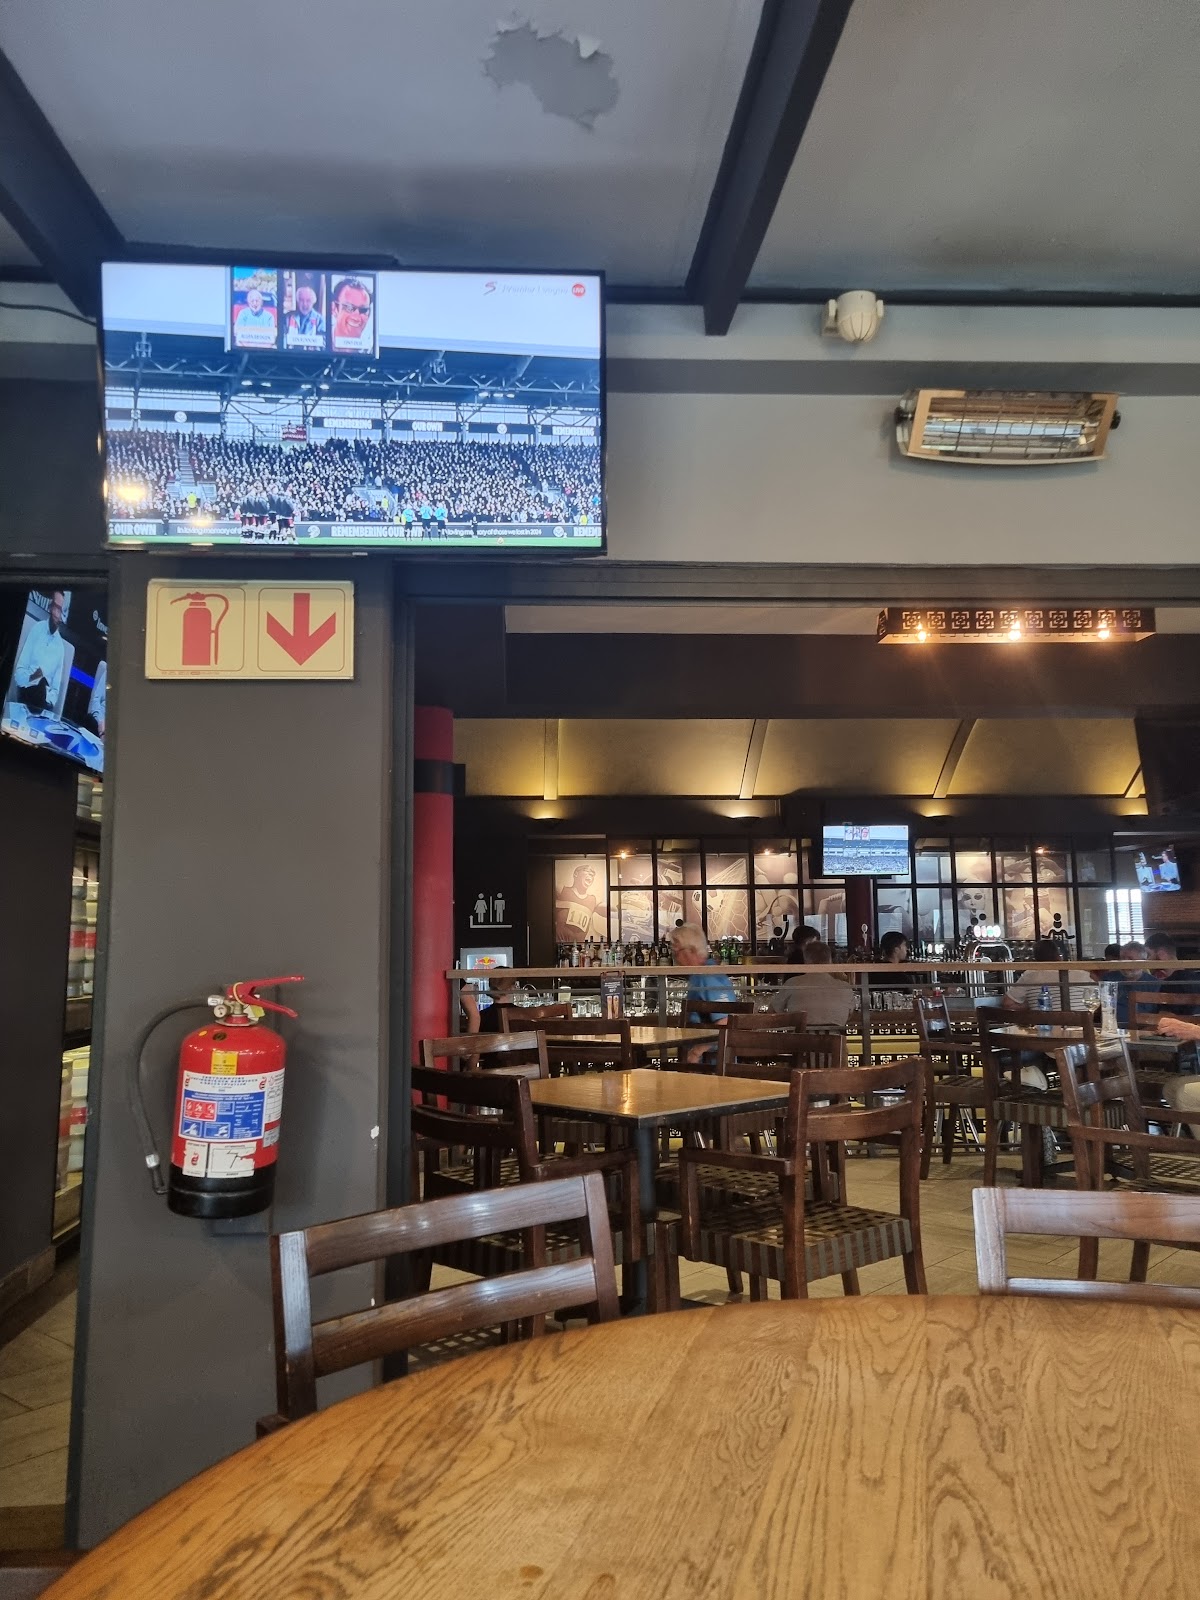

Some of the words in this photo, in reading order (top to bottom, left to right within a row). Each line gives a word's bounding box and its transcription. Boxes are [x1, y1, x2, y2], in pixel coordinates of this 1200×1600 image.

[323, 418, 373, 429] REMEMBERING
[412, 421, 427, 432] OUR
[427, 421, 443, 432] OWN
[552, 426, 595, 436] REMEMBERING
[114, 523, 133, 535] OUR
[133, 523, 157, 535] OWN
[331, 525, 388, 537] REMEMBERING
[388, 525, 405, 537] OUR
